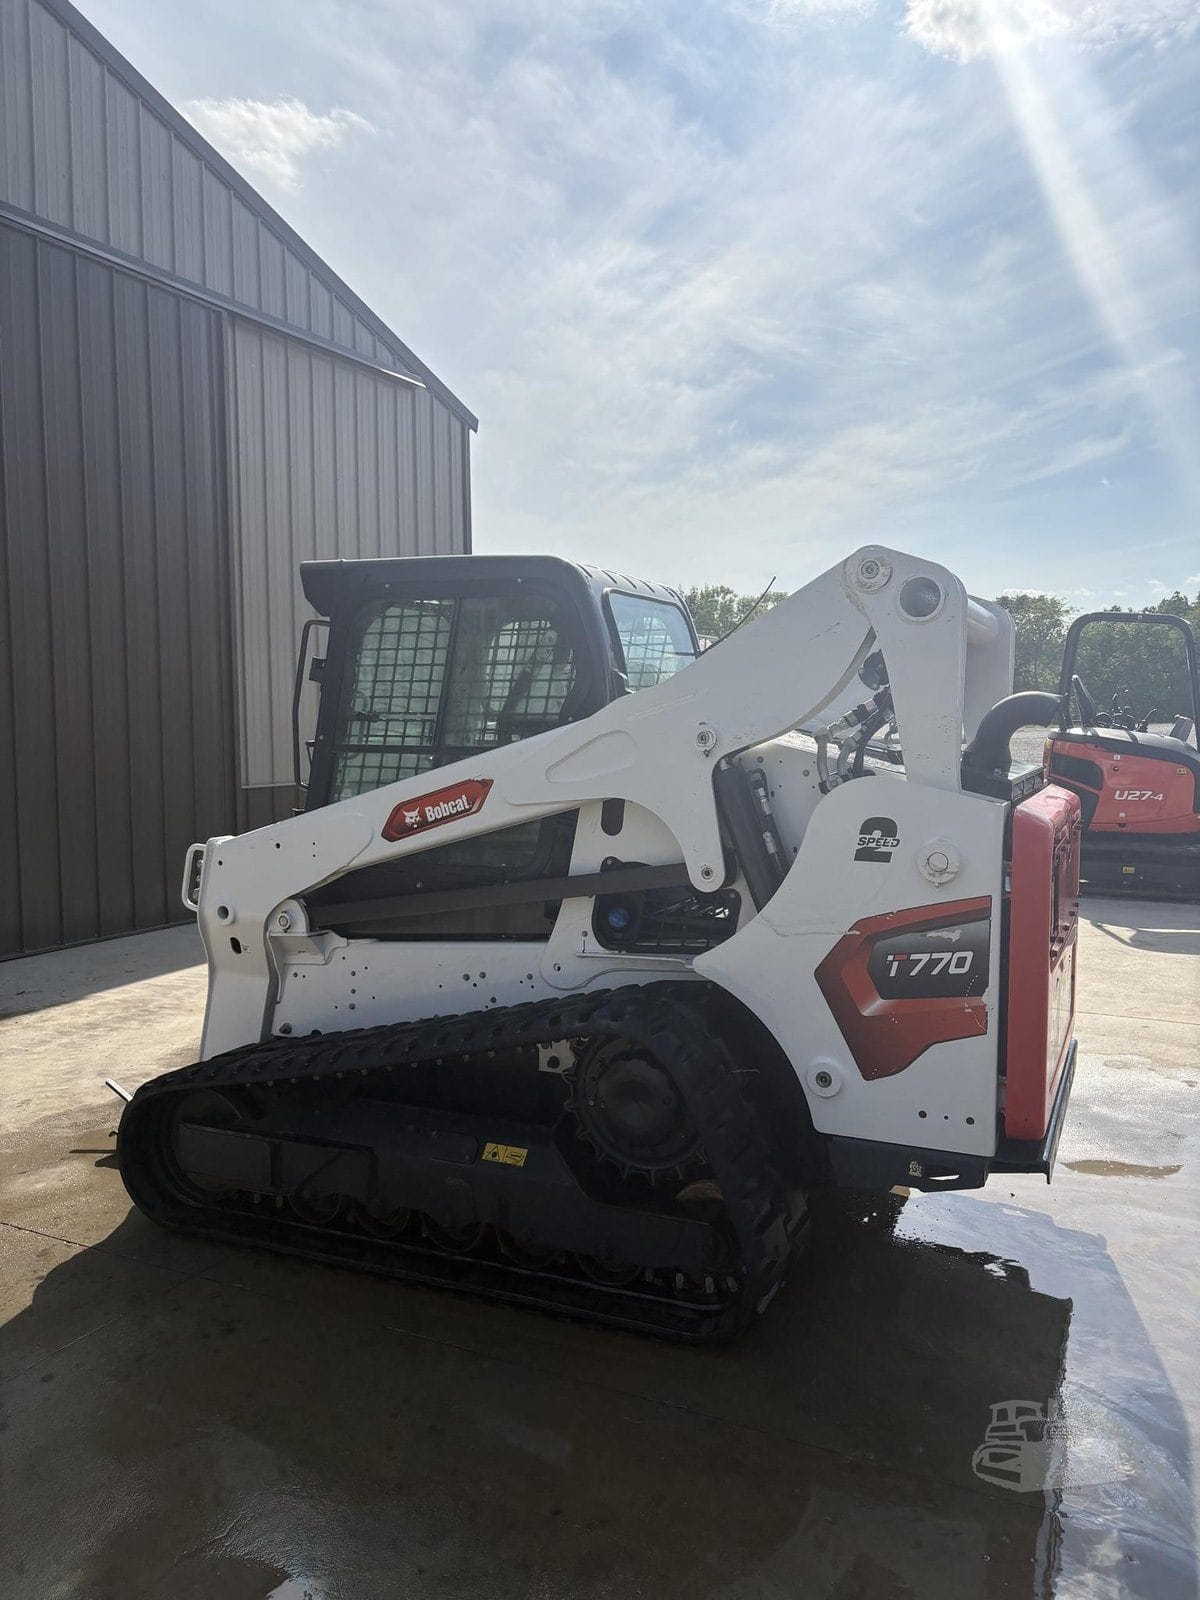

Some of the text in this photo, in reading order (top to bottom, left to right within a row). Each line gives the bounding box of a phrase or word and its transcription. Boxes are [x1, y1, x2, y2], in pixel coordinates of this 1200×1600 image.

[424, 794, 470, 822] Bobcat
[1114, 790, 1164, 801] U27-4
[854, 816, 898, 863] 2
[857, 836, 900, 848] SPEED
[886, 951, 973, 977] T770
